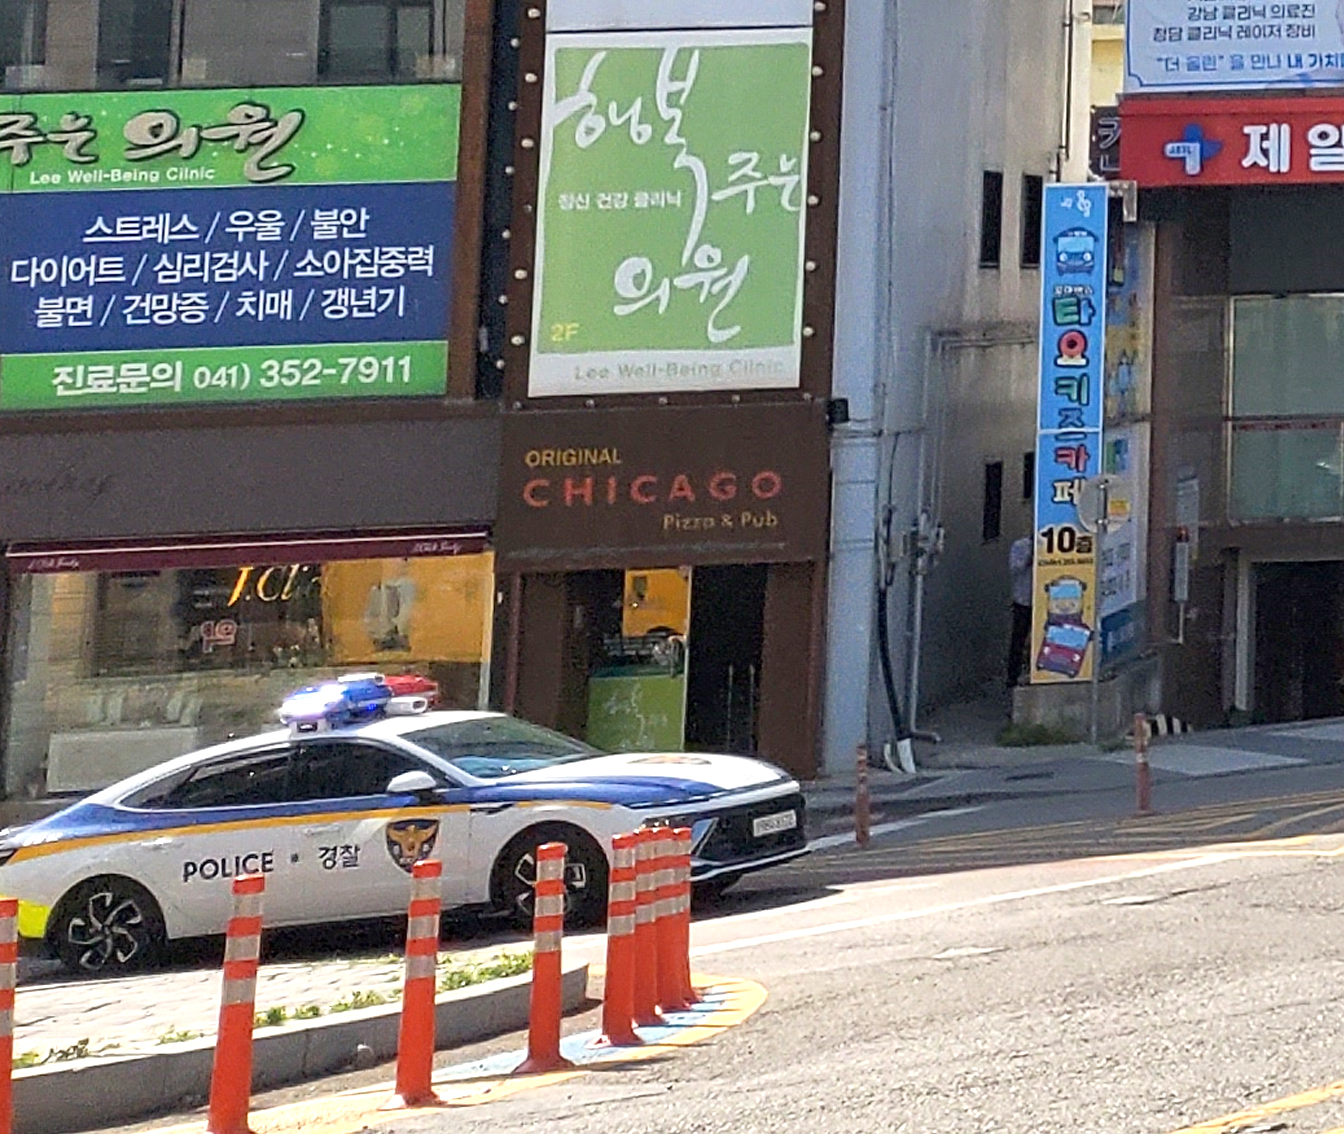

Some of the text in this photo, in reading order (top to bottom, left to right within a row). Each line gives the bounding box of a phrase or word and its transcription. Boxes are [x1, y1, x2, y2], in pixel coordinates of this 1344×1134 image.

[1270, 4, 1316, 20] 의료진
[1237, 24, 1282, 40] 레이저
[1285, 24, 1316, 40] 장비
[123, 102, 304, 184] 의원
[29, 170, 62, 185] Lee
[68, 167, 160, 184] Well-Being
[709, 149, 804, 216] 주는
[558, 190, 682, 210] 정신 건강 클리닉
[82, 207, 370, 245] 스트레스 우울 불안
[10, 245, 435, 288] 다이어트 심리검사 소아집중력
[34, 284, 405, 328] 불면 건망증 치매 갱년기
[613, 244, 750, 343] 의원
[551, 323, 580, 342] 2F
[52, 355, 412, 396] 진료문의 041) 352-7911
[575, 366, 609, 382] Lee
[524, 448, 622, 468] ORIGINAL
[523, 470, 784, 507] CHICAGO
[741, 511, 779, 528] Pub
[1040, 526, 1094, 555] 10층
[183, 844, 362, 884] POLICE 경찰
